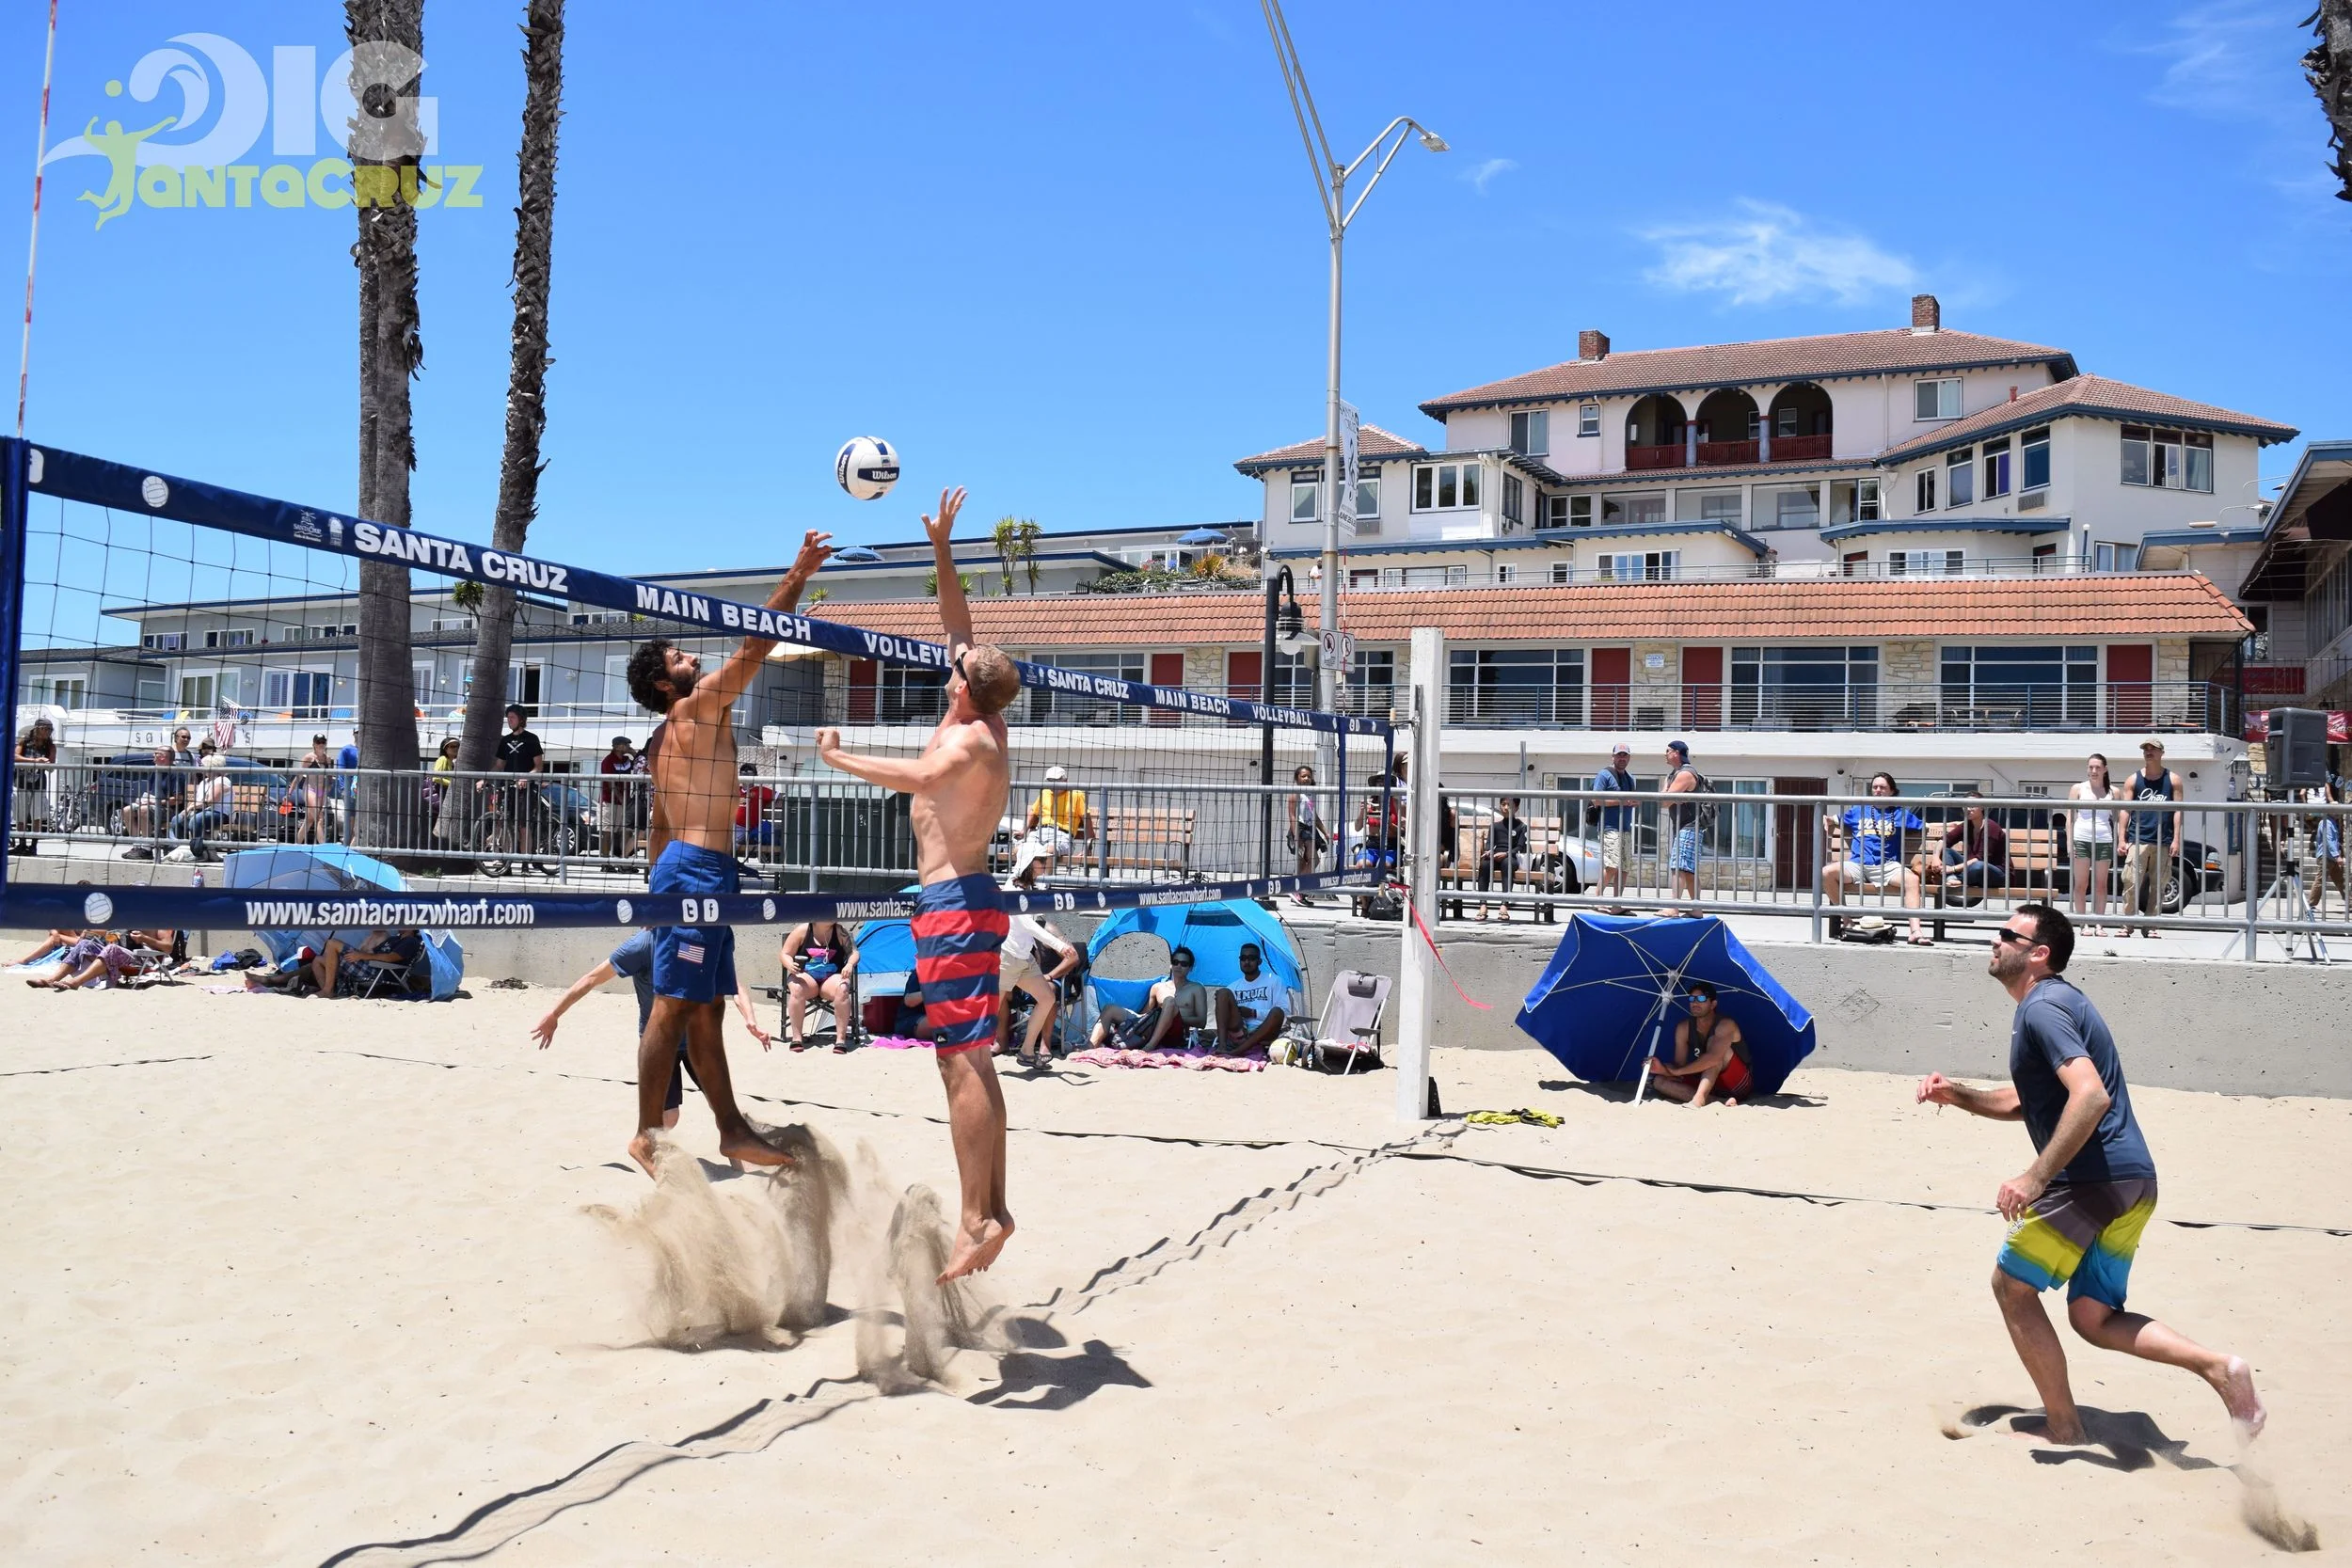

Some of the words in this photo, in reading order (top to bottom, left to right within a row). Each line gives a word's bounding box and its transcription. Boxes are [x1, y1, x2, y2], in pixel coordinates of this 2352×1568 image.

[839, 454, 849, 483] Wilson
[872, 470, 898, 480] Wilson
[354, 522, 473, 573] SANTA
[481, 551, 568, 594] CRUZ
[635, 584, 710, 622] MAIN
[721, 603, 811, 641] BEACH
[1047, 669, 1092, 692] SANTA
[1094, 677, 1129, 699] CRUZ
[1154, 689, 1187, 707] MAIN
[1190, 694, 1231, 715] BEACH
[1251, 705, 1312, 727] VOLLEYBALL
[1138, 886, 1221, 906] www.santacruzwharf.com
[246, 898, 534, 926] www.santacruzwharf.com
[1693, 1047, 1701, 1057] 2
